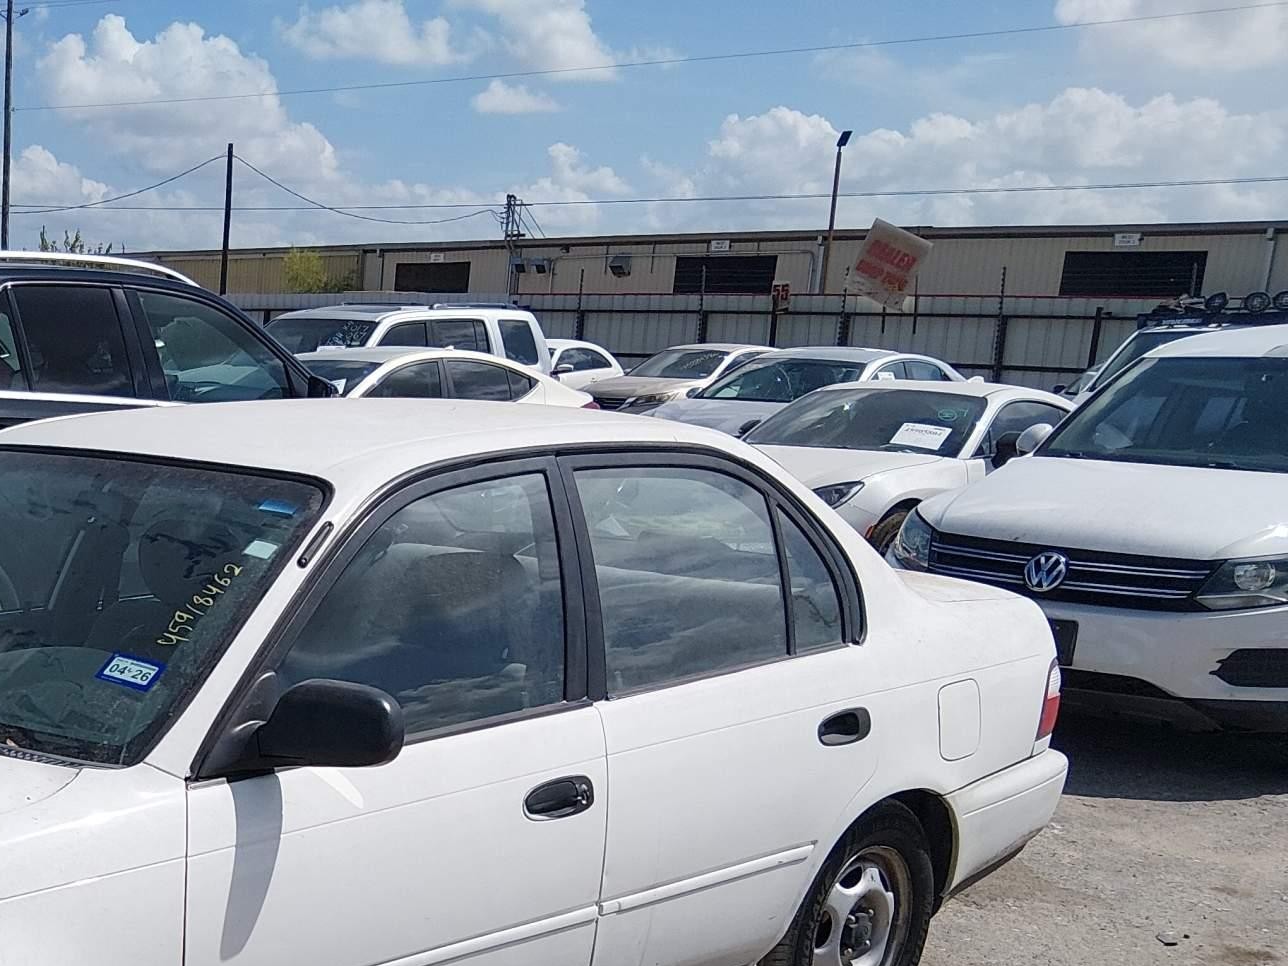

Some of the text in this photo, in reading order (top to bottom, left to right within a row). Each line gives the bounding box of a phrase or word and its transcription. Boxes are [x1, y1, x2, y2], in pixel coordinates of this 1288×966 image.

[774, 284, 790, 300] 55
[1025, 552, 1065, 591] VW
[157, 564, 243, 645] 45918462
[109, 664, 128, 675] 04
[131, 670, 152, 682] 26
